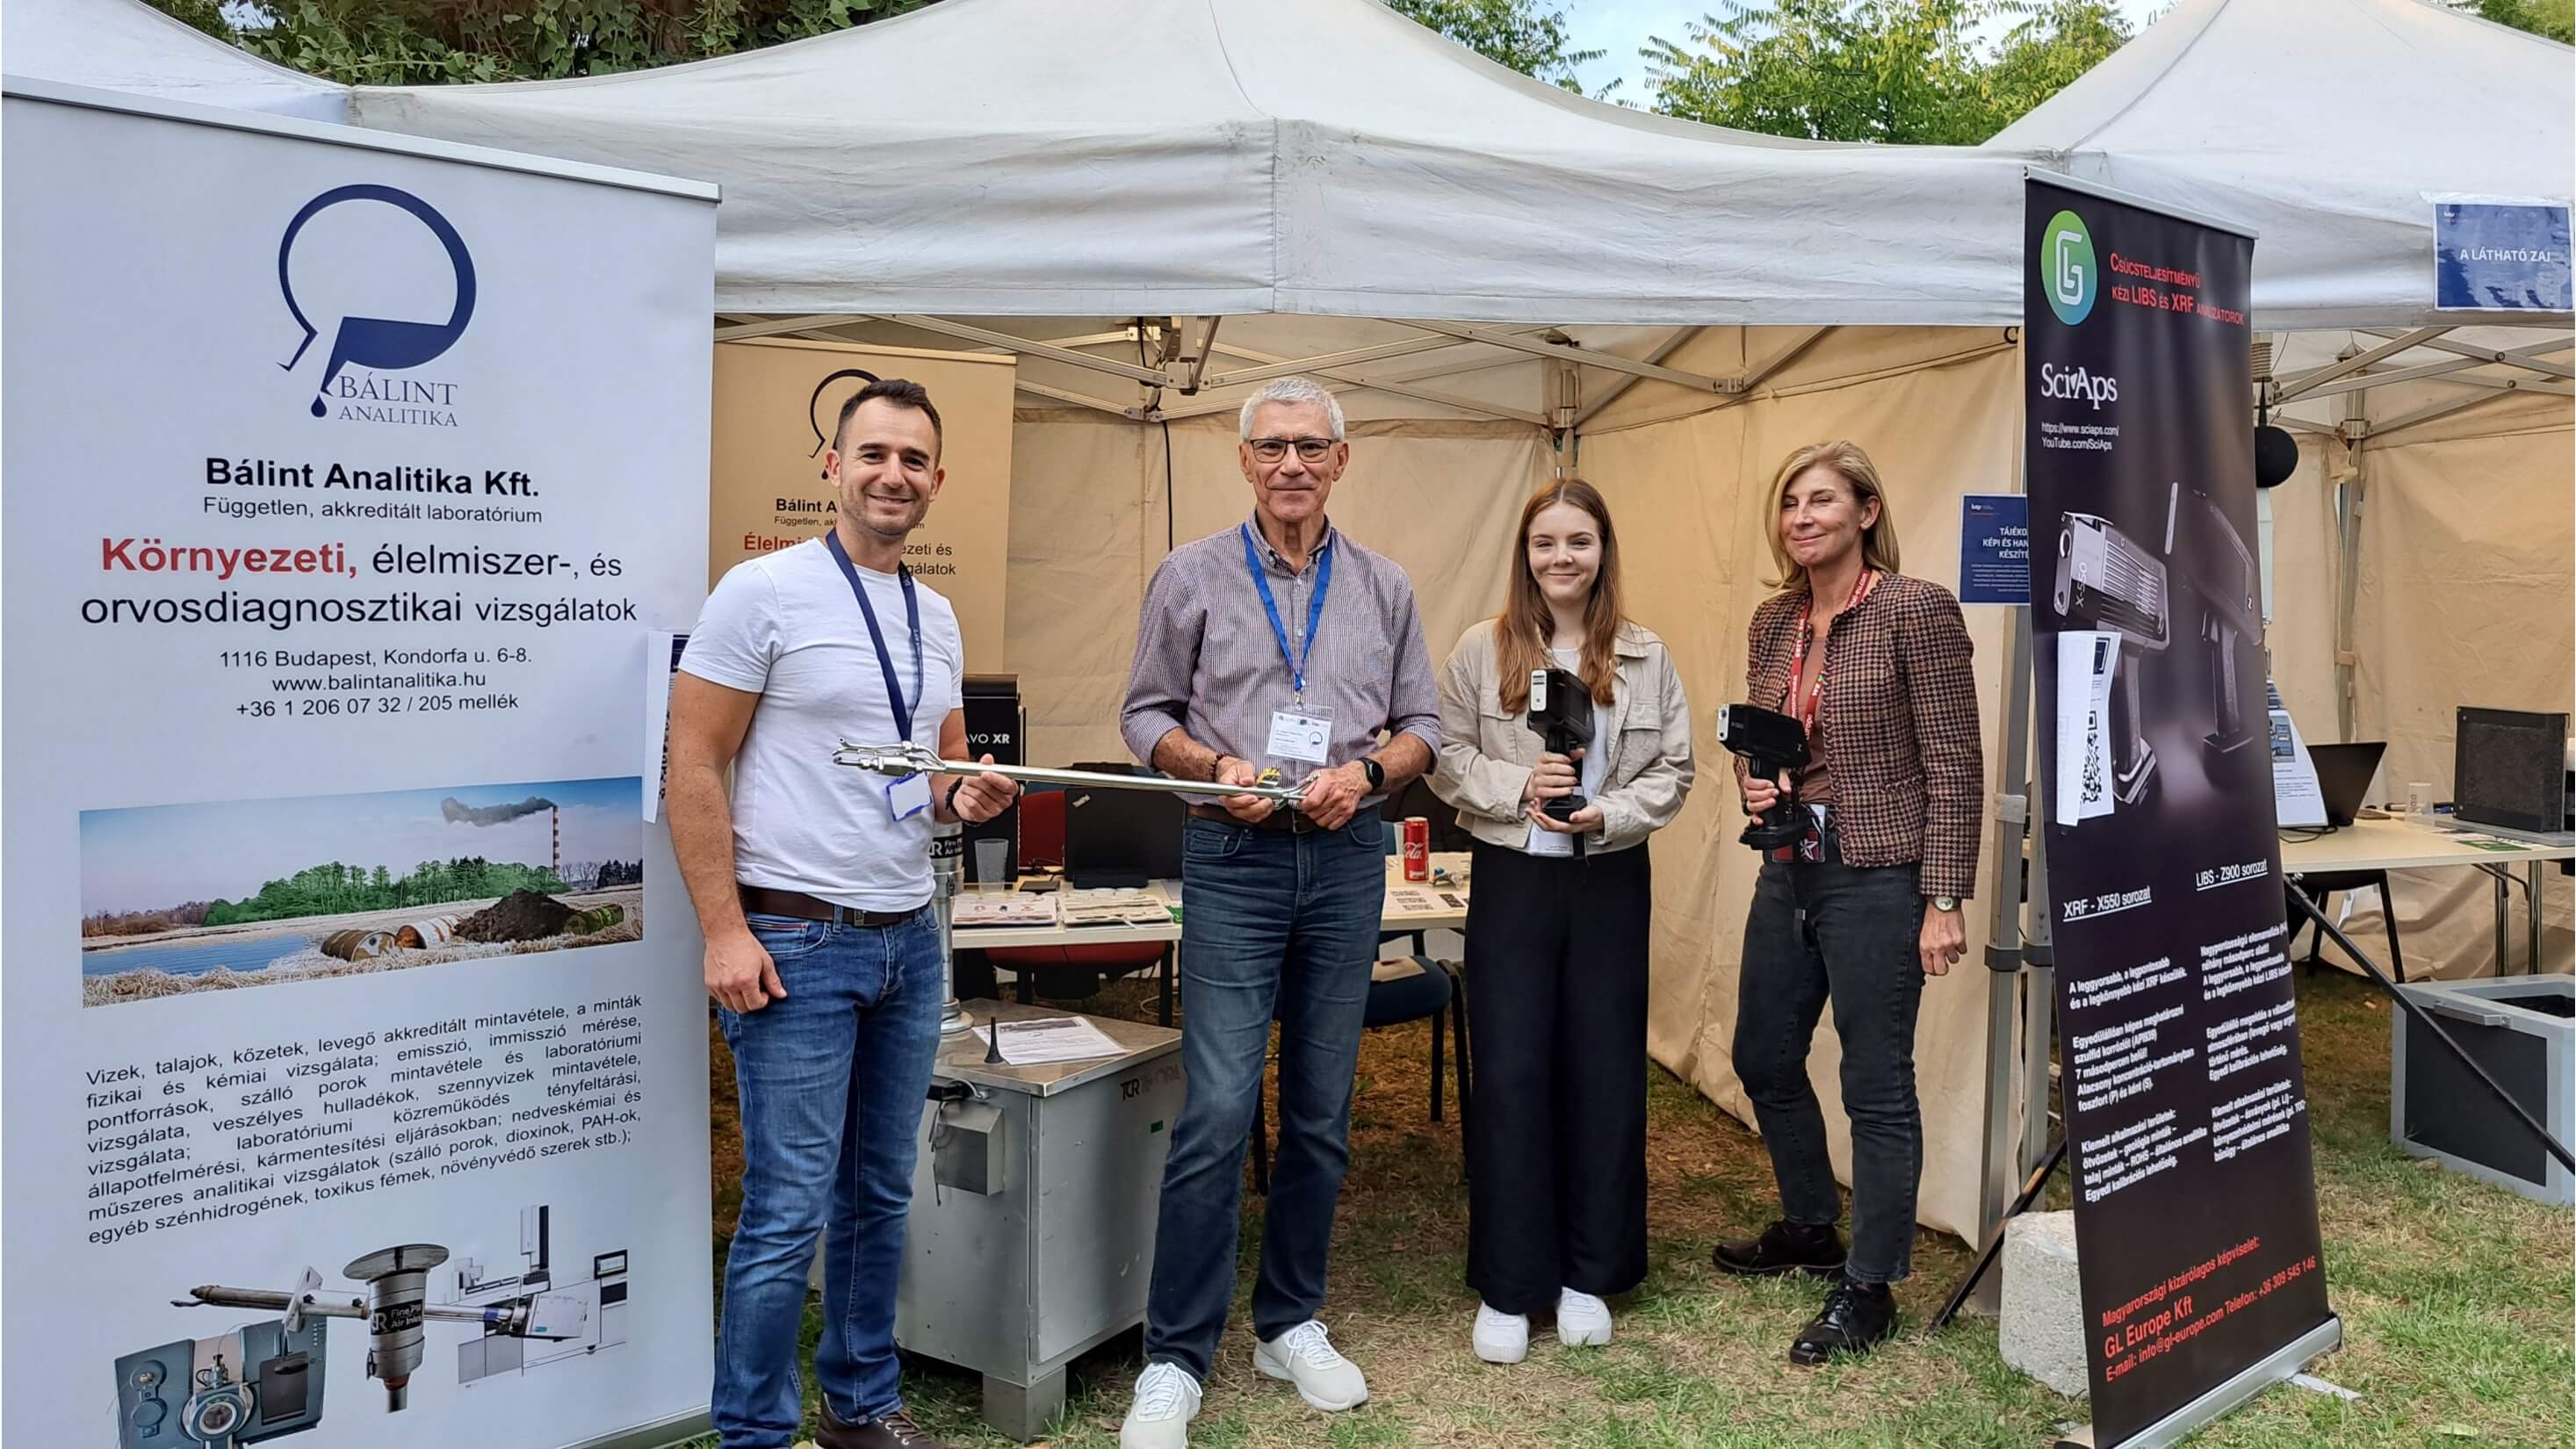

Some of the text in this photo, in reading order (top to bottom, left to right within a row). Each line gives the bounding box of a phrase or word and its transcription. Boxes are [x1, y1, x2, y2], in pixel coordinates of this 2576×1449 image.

[2460, 247, 2551, 262] A LÁTHATÓ ZAJ
[2132, 285, 2157, 306] LIBS
[2172, 292, 2194, 314] XRF
[339, 371, 458, 406] BÁLINT
[2041, 363, 2118, 410] SciAps
[339, 406, 458, 427] ANALITIKA
[206, 457, 539, 496] Bálint Analitika Kft.
[204, 496, 542, 523] Független, akkreditált laboratórium
[774, 516, 821, 526] Független,
[776, 499, 821, 513] Bálint
[1982, 537, 2000, 547] KÉPI
[2002, 537, 2011, 546] ÉS
[2000, 526, 2027, 536] TÁJÉKO
[102, 537, 622, 580] Környezeti, élelmiszer-, és
[901, 543, 952, 555] ezeti és
[1999, 549, 2029, 559] KÉSZÍTÉ
[908, 564, 956, 575] gálatok
[81, 592, 637, 631] orvosdiagnosztikai vizsgálatok
[220, 647, 531, 669] 1116 Budapest, Kondorfa u. 6-8.
[272, 672, 486, 691] www.balintanalitika.hu
[236, 694, 519, 717] +36 1 206 07 32 / 205 mellék
[992, 734, 1010, 744] XR
[2196, 859, 2268, 887] LIBS Z900 sorozat
[2064, 885, 2151, 918] XRF X550 sorozat
[2069, 982, 2076, 994] A
[86, 995, 641, 1085] Vizek, talajok, kőzetek, levegő akkreditált mintavétele, a minták
[86, 1015, 641, 1108] fizikai és kémiai vizsgálata; emisszió, immisszió mérése,
[88, 1032, 641, 1134] pontforrások, szálló porok mintavétele és laboratóriumi
[88, 1054, 641, 1152] vizsgálata, veszélyes hulladékok, szennyvizek mintavétele,
[88, 1071, 641, 1176] vizsgálata; laboratóriumi közreműködés tényfeltárási,
[88, 1091, 641, 1198] állapotfelmérési, kármentesítési eljárásokban; nedveskémiai és
[89, 1109, 640, 1221] műszeres analitikai vizsgálatok (szálló porok, dioxinok, PAH-ok,
[89, 1128, 631, 1244] egyéb szénhidrogének, toxikus fémek, növényvédő szerek stb.);
[2168, 1258, 2216, 1294] kizárólagos
[2104, 1296, 2193, 1358] GL Europe Kft
[2106, 1355, 2137, 1382] E-mail:
[2139, 1307, 2224, 1364] info@gl-europe.com
[2225, 1290, 2257, 1315] Telefon:
[2259, 1280, 2271, 1297] +36
[2272, 1271, 2286, 1287] 309
